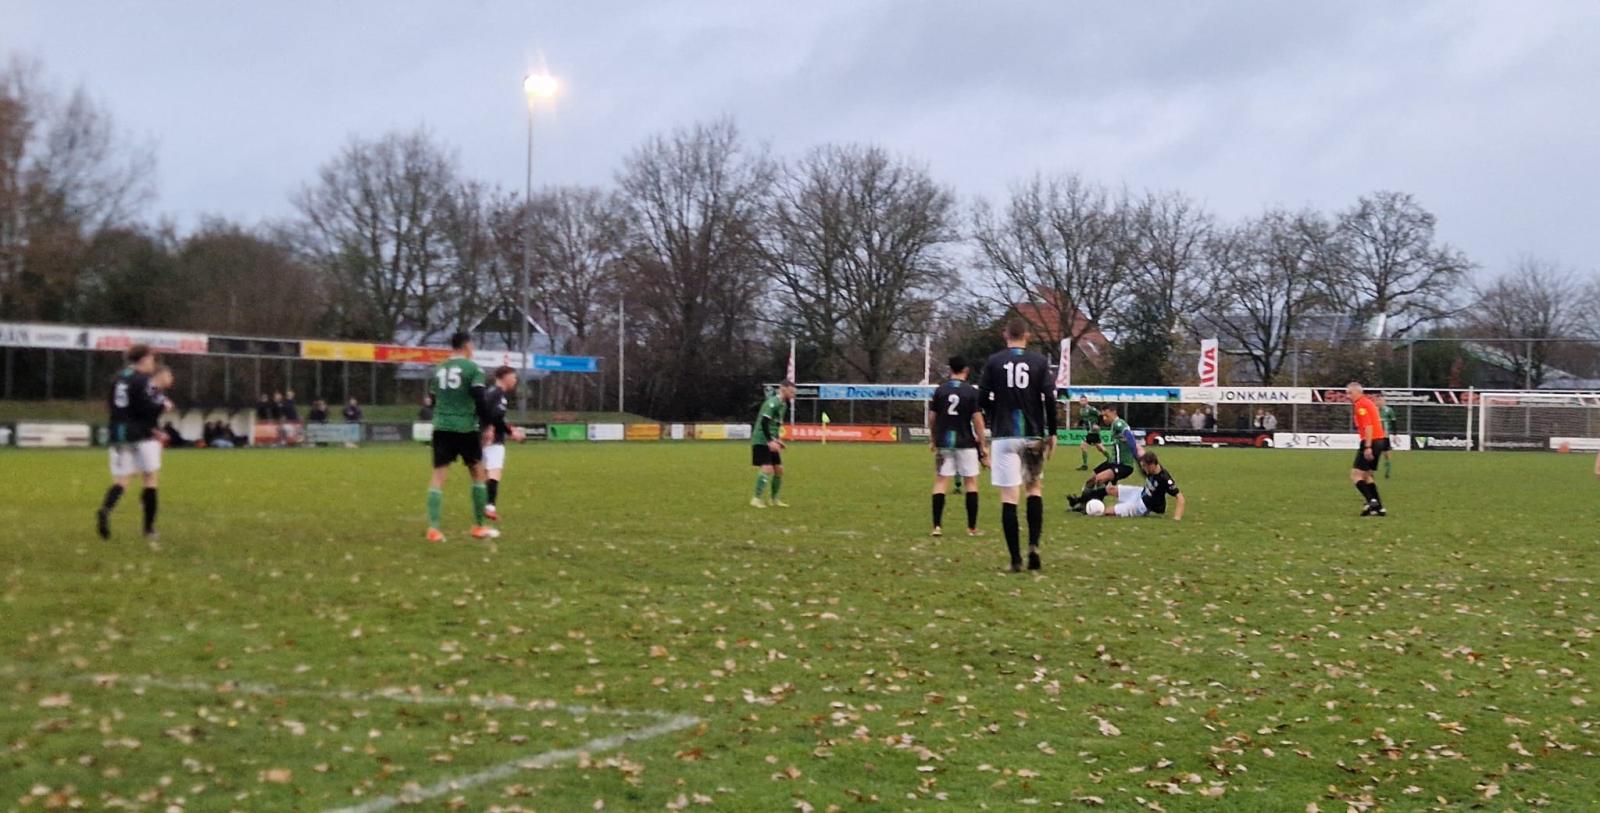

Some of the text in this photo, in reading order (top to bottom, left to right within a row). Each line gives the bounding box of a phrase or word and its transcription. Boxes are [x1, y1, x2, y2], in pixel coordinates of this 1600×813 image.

[436, 366, 462, 390] 15
[1003, 361, 1030, 389] 16
[947, 393, 960, 416] 2
[1219, 391, 1289, 401] JONKMAN
[1307, 435, 1330, 447] PK
